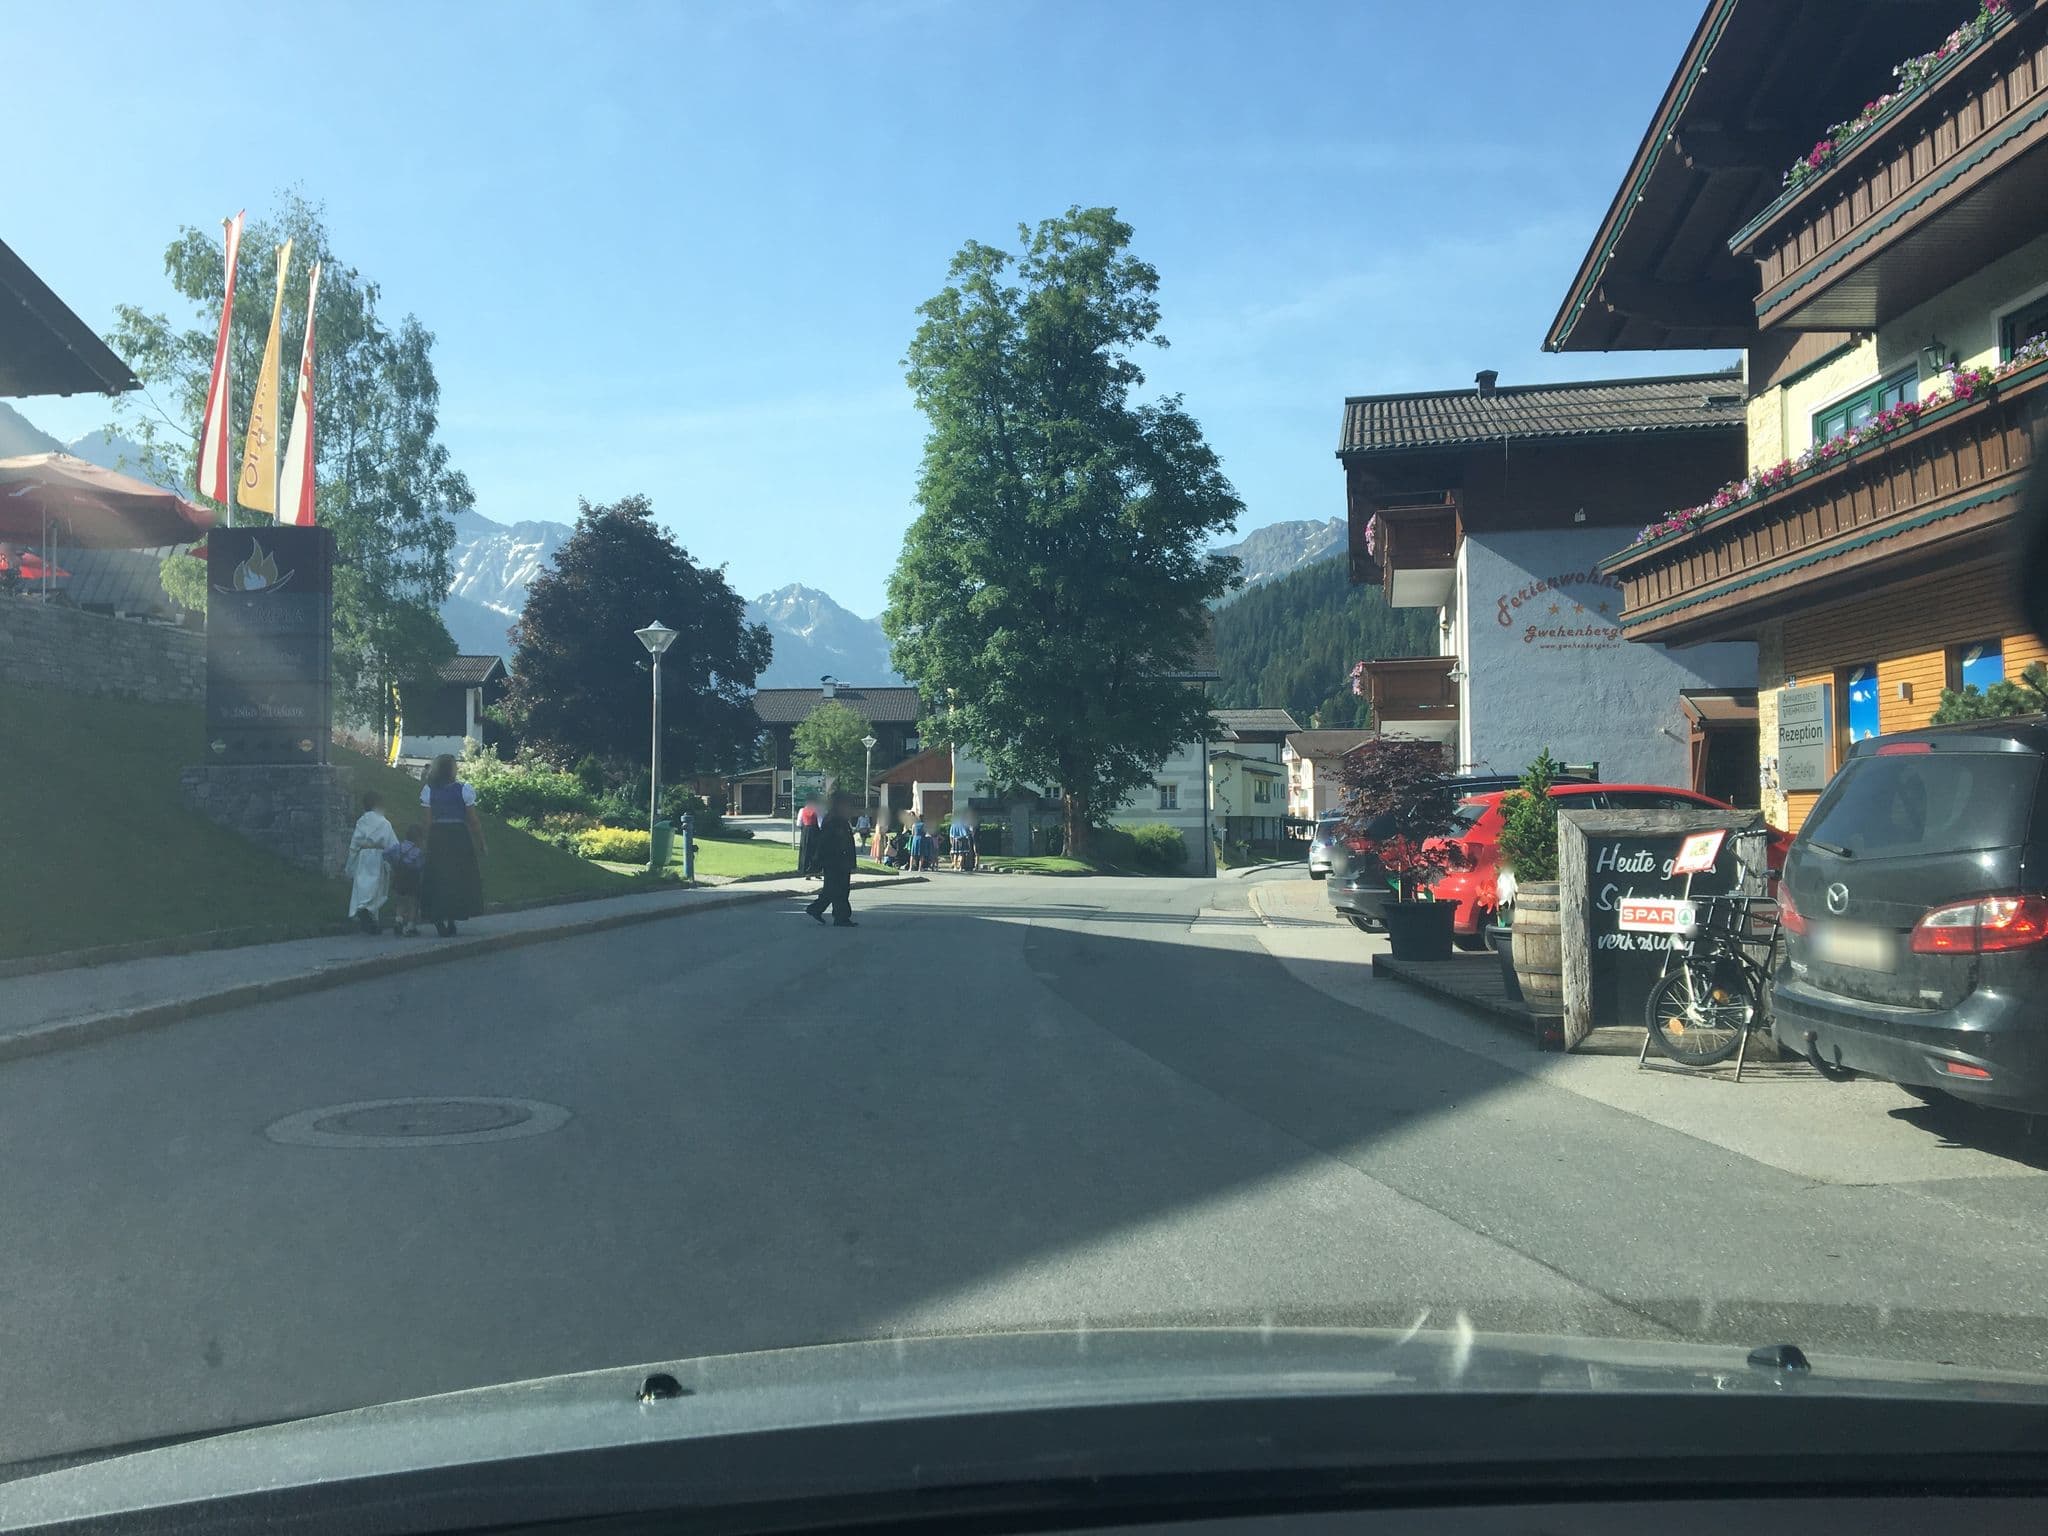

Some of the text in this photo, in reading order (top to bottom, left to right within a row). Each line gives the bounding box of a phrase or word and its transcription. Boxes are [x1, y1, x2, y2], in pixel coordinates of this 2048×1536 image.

[1780, 724, 1823, 743] Rezeption
[1596, 842, 1656, 873] Heute
[1622, 908, 1674, 922] SPAR
